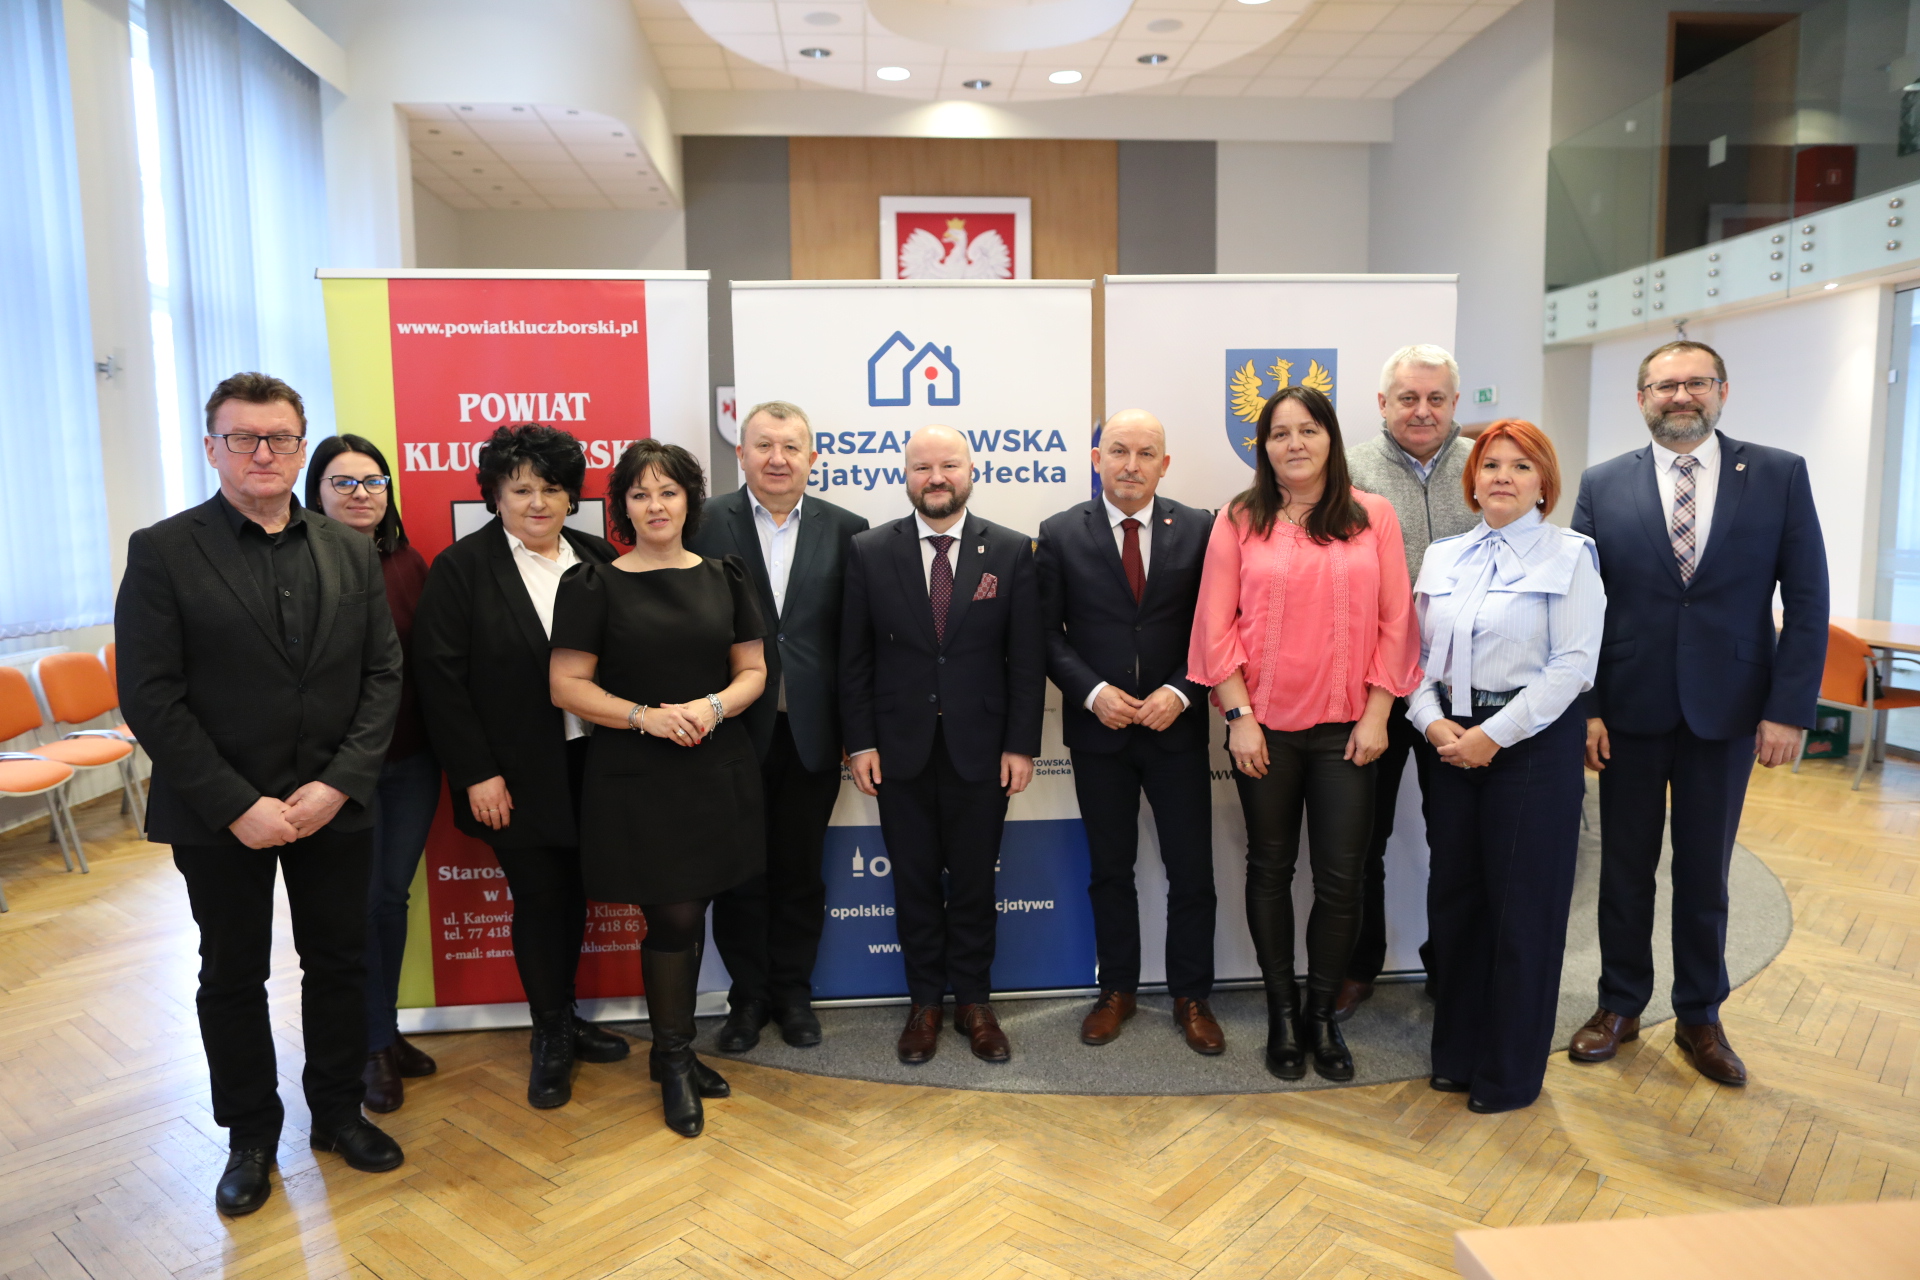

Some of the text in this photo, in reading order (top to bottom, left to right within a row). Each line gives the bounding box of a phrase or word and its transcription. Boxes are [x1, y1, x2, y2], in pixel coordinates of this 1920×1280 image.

[397, 320, 639, 337] www.powiatkluczborski.pl
[458, 392, 591, 423] POWIAT
[807, 460, 1066, 492] cjatyw ołecka
[438, 865, 506, 881] Staros
[483, 890, 499, 902] w
[443, 912, 459, 925] ul.
[463, 911, 514, 924] Katowic
[594, 904, 643, 918] Kluczbo
[831, 898, 1054, 920] opolskie cjatywa
[444, 927, 464, 940] tel.
[467, 928, 483, 939] 77
[487, 925, 511, 938] 418
[599, 920, 621, 932] 418
[624, 920, 640, 932] 65
[445, 947, 483, 960] e-mail:
